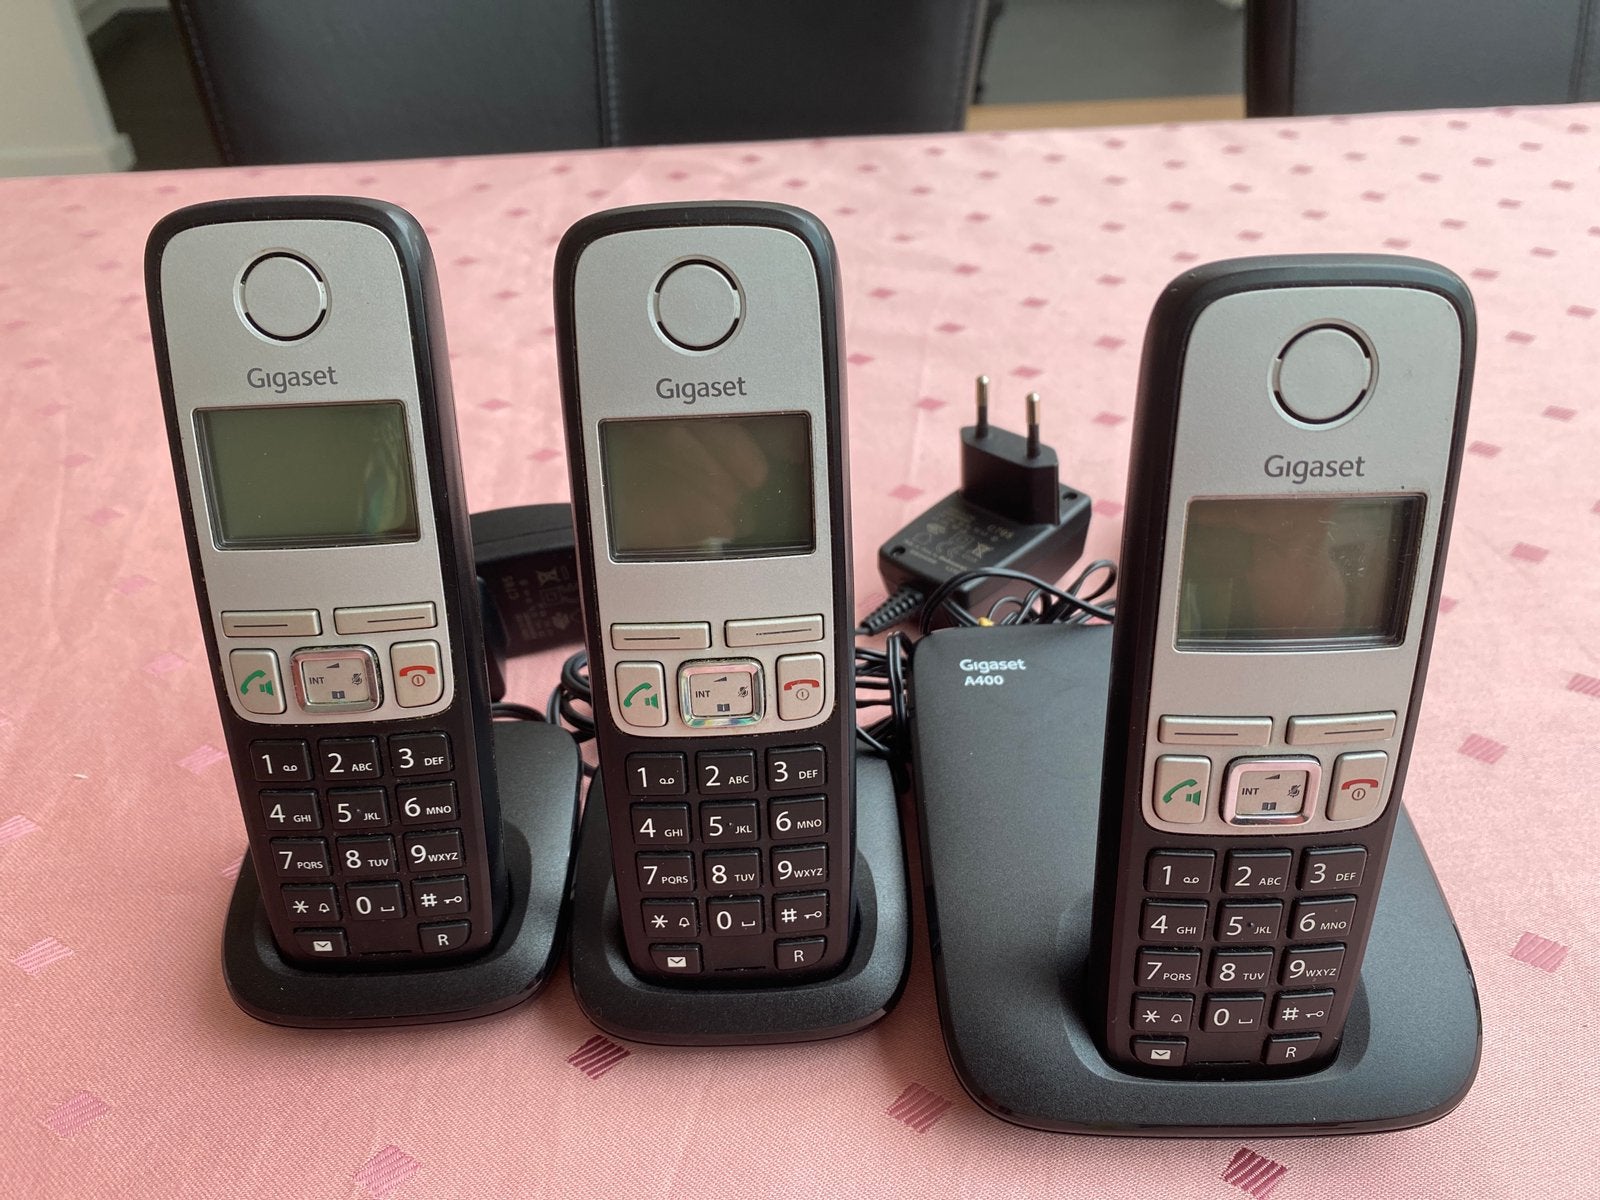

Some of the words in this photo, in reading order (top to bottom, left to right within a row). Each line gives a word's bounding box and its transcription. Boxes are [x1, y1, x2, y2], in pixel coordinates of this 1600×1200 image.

[246, 366, 339, 394] Gigaset
[655, 376, 748, 405] Gigaset
[1263, 454, 1366, 485] Gigaset
[959, 658, 1027, 674] Gigaset
[308, 676, 325, 685] INT
[964, 674, 1005, 686] A400
[695, 690, 711, 699] INT
[261, 754, 273, 774] 1
[327, 752, 345, 773] 2
[351, 762, 373, 772] ABC
[398, 747, 415, 769] 3
[424, 756, 444, 766] DEF
[637, 767, 647, 788] 1
[705, 765, 721, 787] 2
[728, 774, 749, 785] ABC
[774, 761, 789, 783] 3
[798, 769, 818, 780] DEF
[1241, 787, 1260, 796] INT
[269, 803, 286, 823] 4
[293, 814, 312, 823] GHI
[337, 803, 352, 823] 5
[363, 812, 381, 821] JKL
[404, 797, 421, 817] 6
[426, 805, 452, 815] MNO
[639, 817, 657, 838] 4
[664, 828, 683, 838] GHI
[709, 816, 723, 837] 5
[735, 825, 753, 834] JKL
[775, 810, 792, 832] 6
[797, 818, 822, 830] MNO
[278, 851, 293, 870] 7
[296, 861, 324, 870] PQRS
[345, 849, 362, 869] 8
[367, 858, 389, 867] TUV
[410, 844, 427, 864] 9
[427, 852, 459, 862] WXYZ
[643, 865, 658, 885] 7
[661, 875, 689, 885] PQRS
[711, 864, 728, 884] 8
[734, 873, 755, 882] TUV
[777, 860, 793, 880] 9
[793, 867, 823, 878] WXYZ
[1162, 865, 1172, 886] 1
[1234, 866, 1252, 887] 2
[1258, 876, 1282, 886] ABC
[1309, 863, 1327, 884] 3
[1335, 872, 1357, 882] DEF
[356, 896, 372, 915] 0
[420, 892, 438, 908] #
[716, 910, 732, 930] 0
[780, 908, 798, 923] #
[1150, 914, 1169, 934] 4
[1176, 926, 1197, 935] GHI
[1299, 912, 1316, 932] 6
[1320, 921, 1347, 930] MNO
[1226, 916, 1244, 936] 5
[1253, 926, 1272, 935] JKL
[437, 933, 449, 946] R
[794, 949, 804, 963] R
[1146, 961, 1163, 980] 7
[1162, 972, 1192, 982] PQRS
[1219, 962, 1236, 982] 8
[1243, 972, 1265, 981] TUV
[1289, 959, 1306, 979] 9
[1305, 967, 1337, 977] WXYZ
[1213, 1008, 1230, 1026] 0
[1281, 1006, 1300, 1021] #
[1285, 1046, 1297, 1058] R
